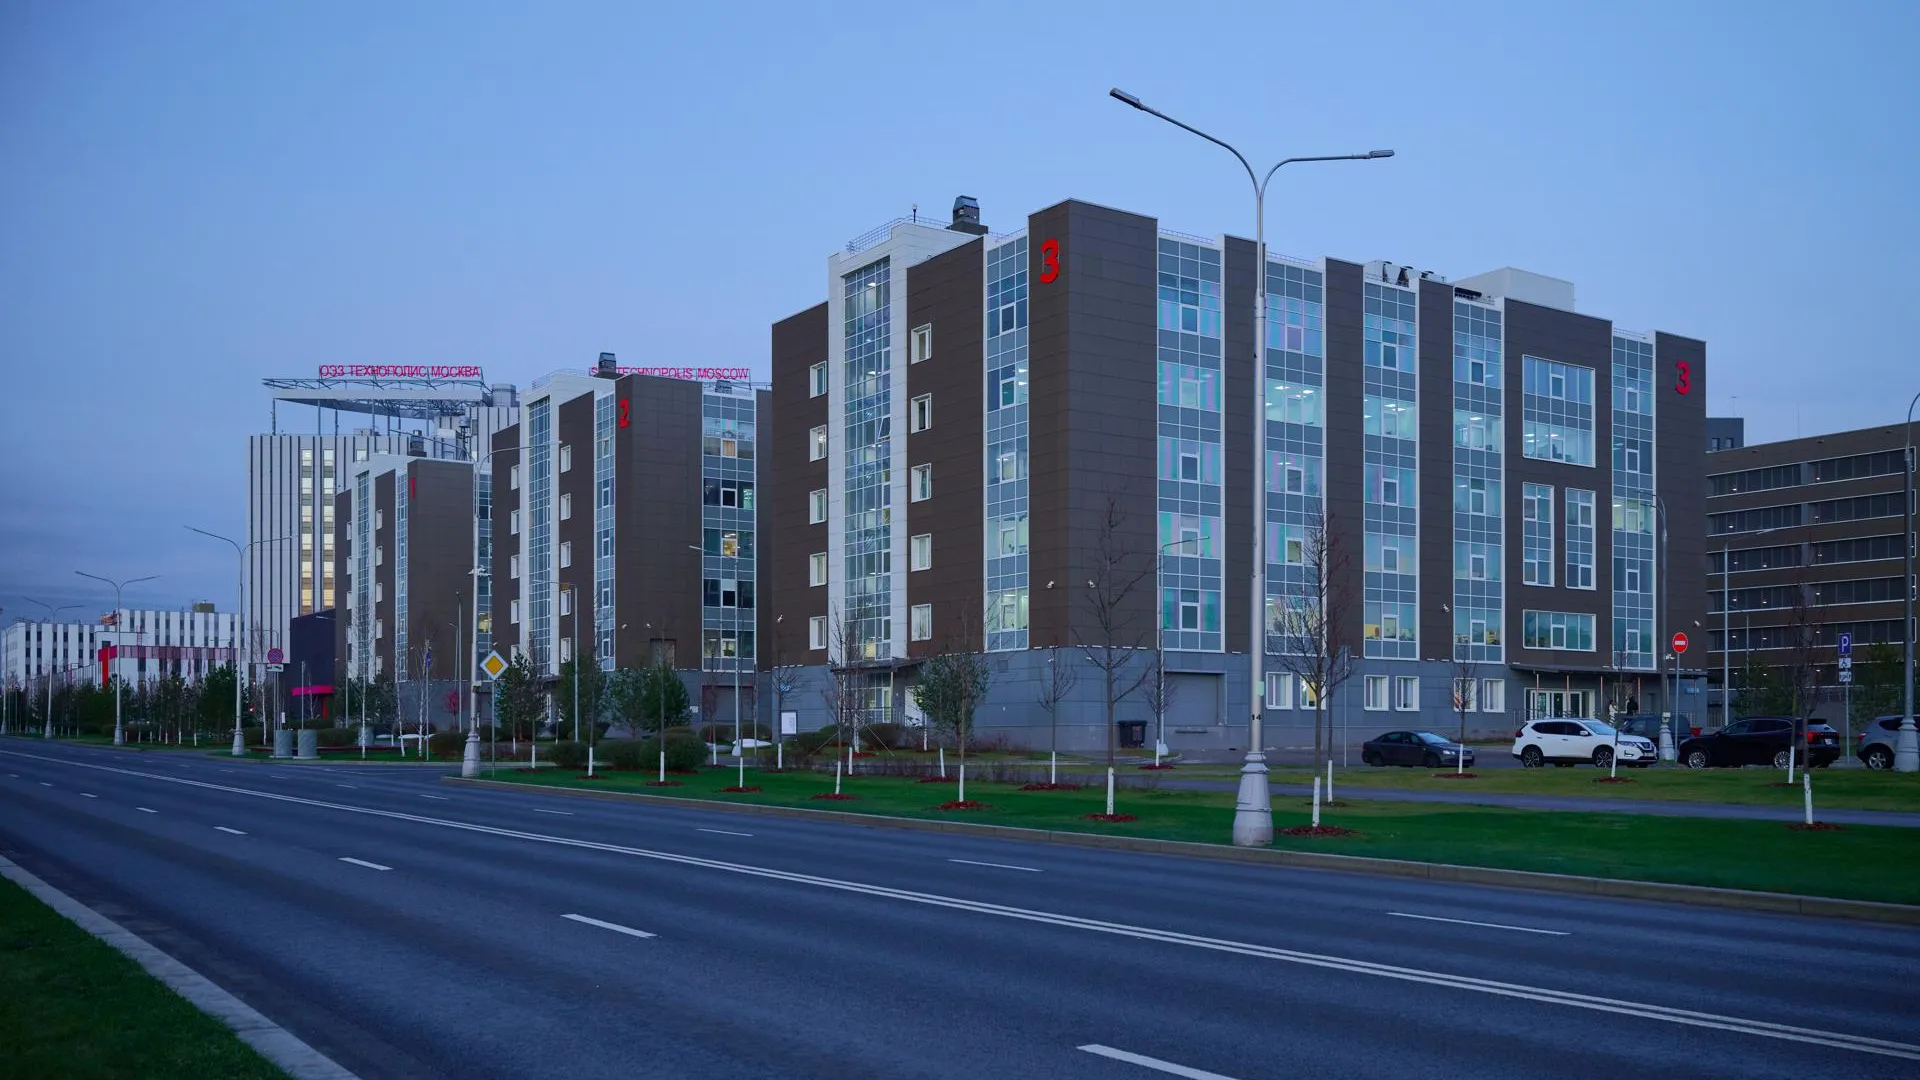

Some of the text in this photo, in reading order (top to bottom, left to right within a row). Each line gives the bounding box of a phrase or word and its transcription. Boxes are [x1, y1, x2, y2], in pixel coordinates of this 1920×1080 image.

[1040, 238, 1060, 284] 3
[319, 365, 480, 378] ОЭЗ ТЕХНОПОЛИС МОСКВА
[697, 367, 749, 380] MOSCOW
[1675, 360, 1691, 396] 3
[619, 398, 630, 429] 2
[1841, 635, 1849, 652] P
